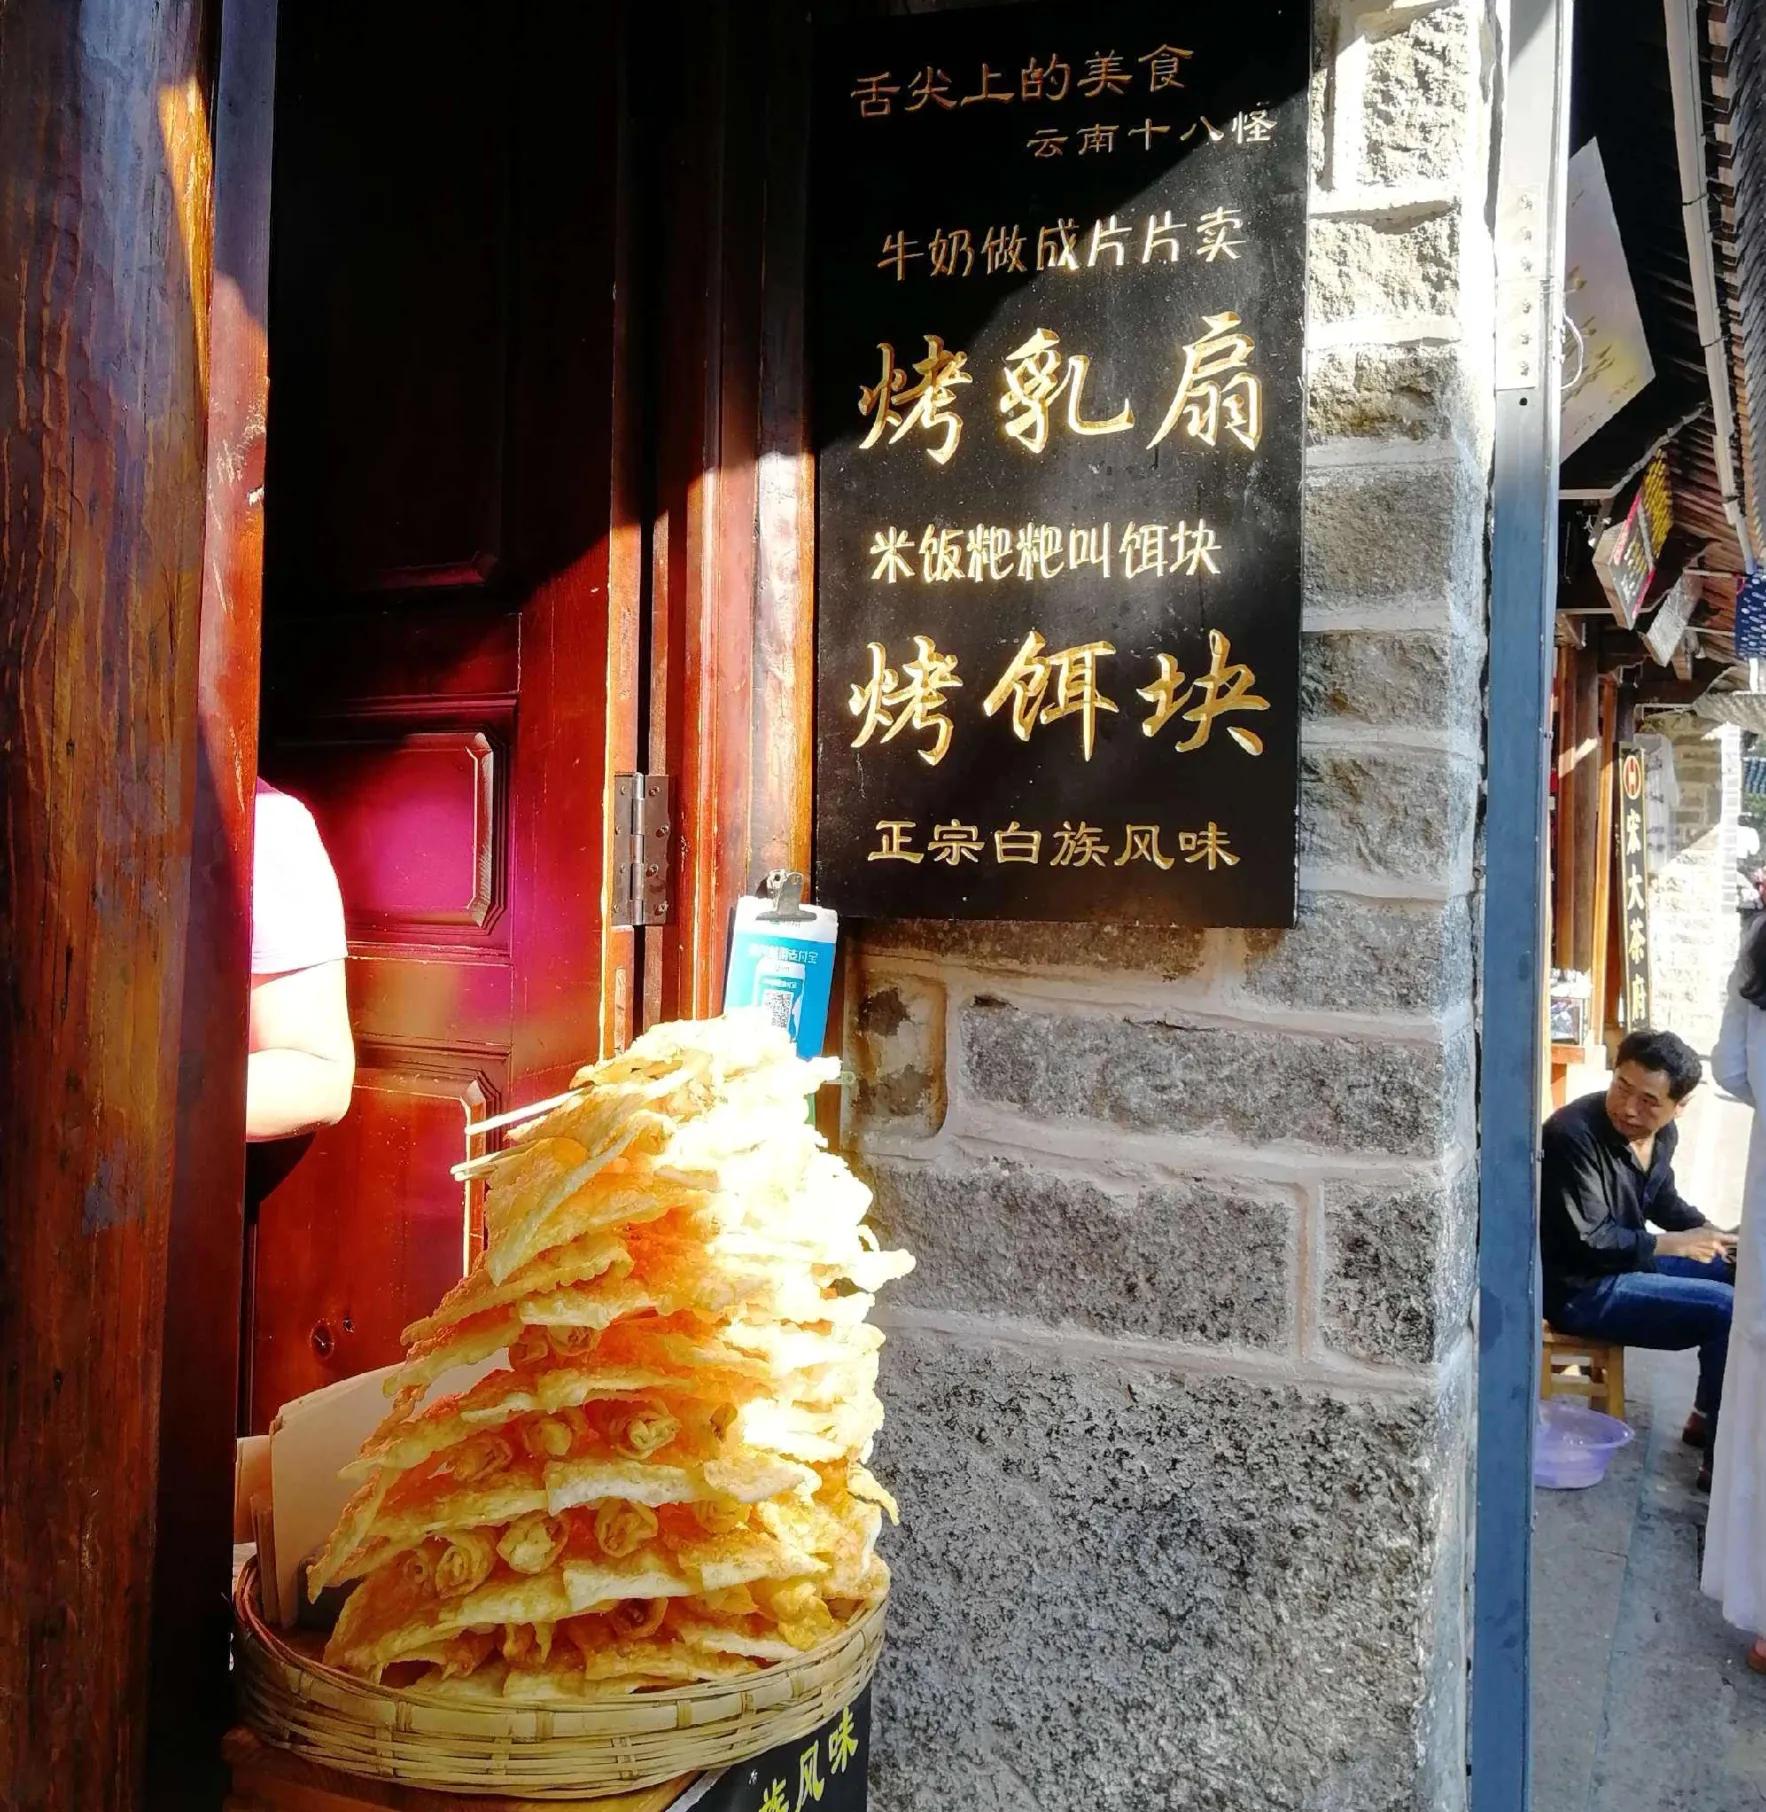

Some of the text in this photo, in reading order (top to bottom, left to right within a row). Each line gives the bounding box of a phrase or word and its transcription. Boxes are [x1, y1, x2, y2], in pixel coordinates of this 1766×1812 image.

[851, 44, 1194, 118] 舌尖上的美食
[1027, 107, 1277, 157] 云南十八怪
[878, 206, 1246, 281] 牛奶做成片片卖
[858, 311, 1263, 464] 烤乳扇
[869, 518, 1222, 584] 米饭粑粑叫饵块
[848, 628, 1271, 766] 烤饵块
[868, 818, 1241, 871] 正宗白族风味
